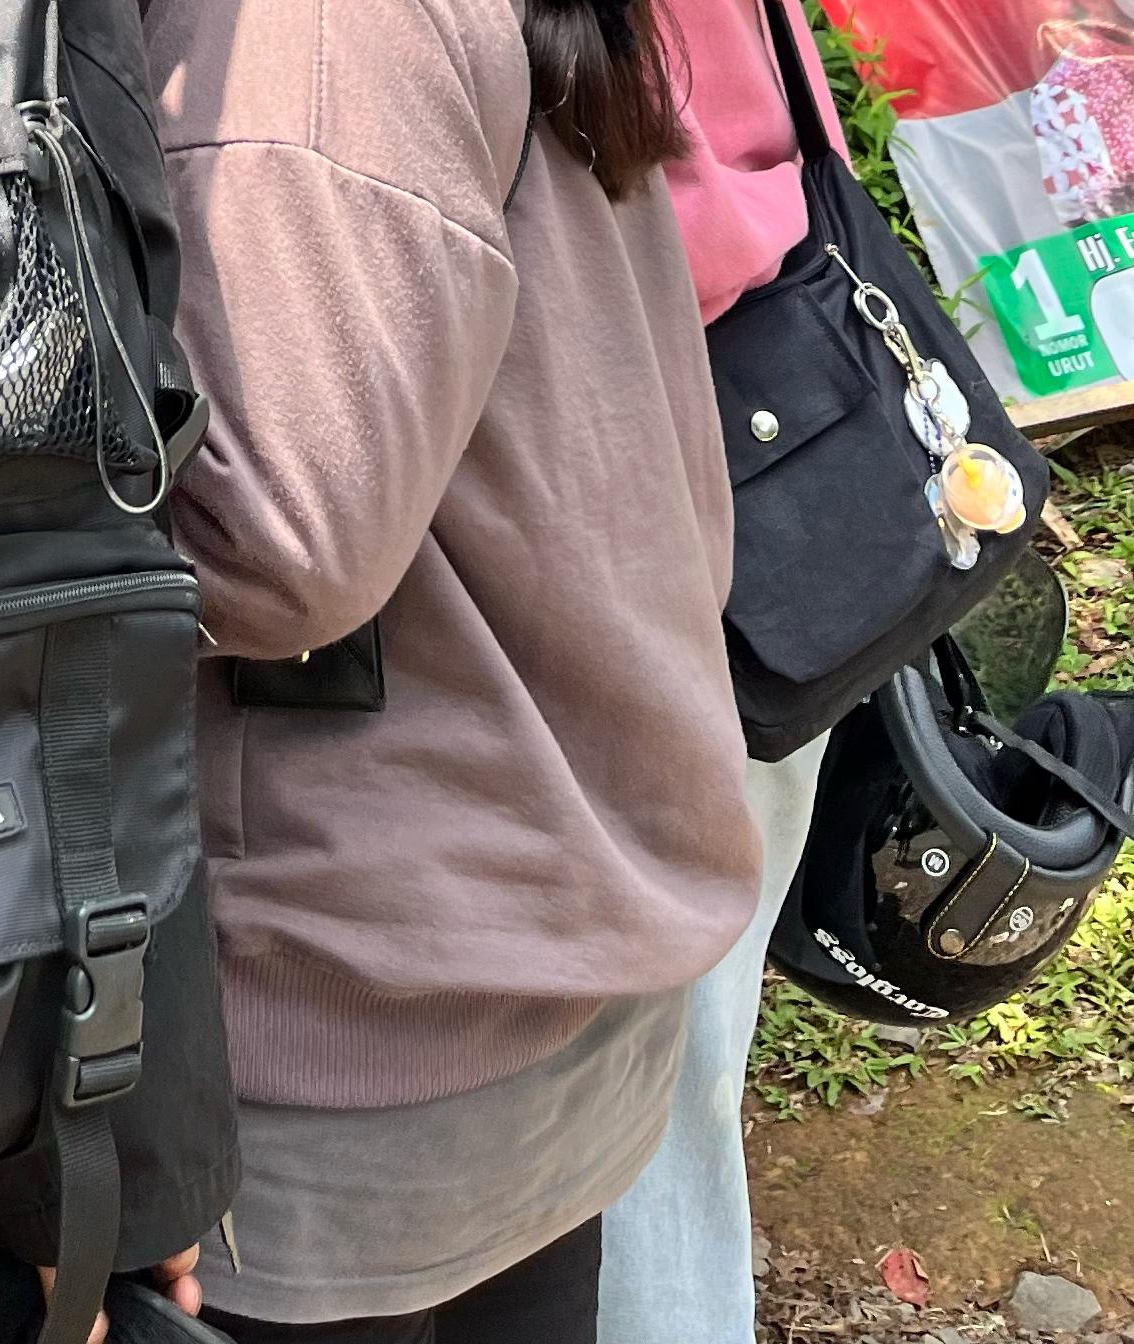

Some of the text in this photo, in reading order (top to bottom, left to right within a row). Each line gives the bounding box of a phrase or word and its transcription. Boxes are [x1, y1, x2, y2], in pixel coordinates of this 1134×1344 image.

[1010, 248, 1087, 342] 1
[1076, 232, 1122, 274] Hj.
[1037, 334, 1089, 358] NOMOR
[1047, 351, 1096, 378] URUT
